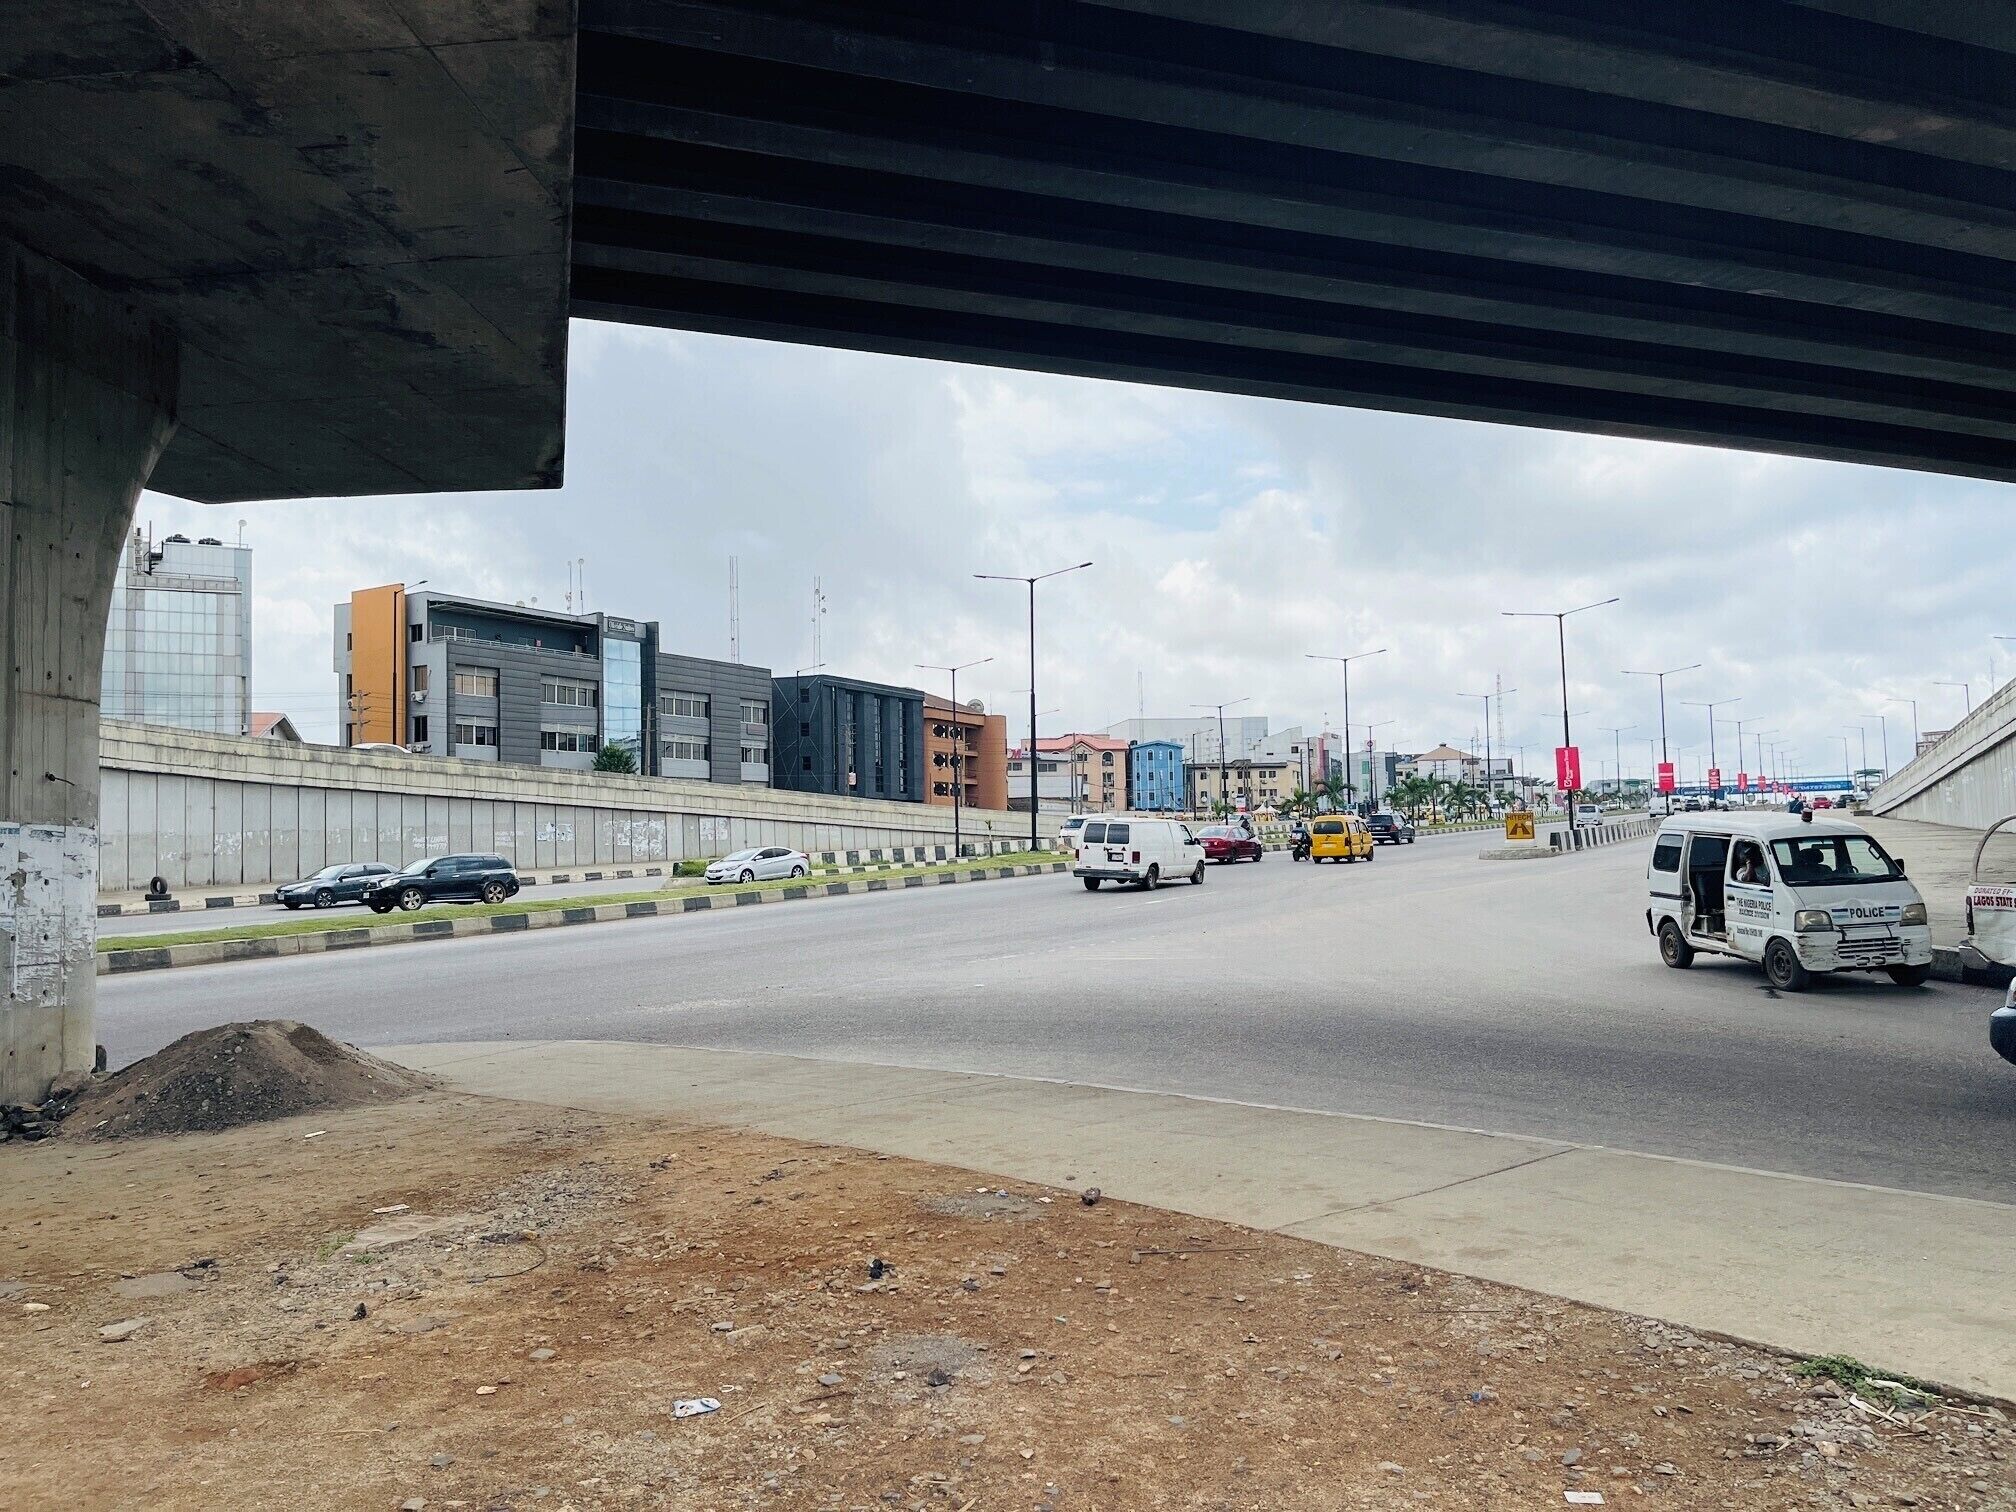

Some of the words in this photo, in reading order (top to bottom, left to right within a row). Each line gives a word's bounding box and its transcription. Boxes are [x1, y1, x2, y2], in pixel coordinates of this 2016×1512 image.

[1744, 899, 1757, 908] NIGERIA
[1758, 900, 1771, 911] POLICE
[1974, 896, 1994, 906] LAGOS
[1996, 897, 2012, 907] STATE
[1849, 906, 1884, 918] POLICE
